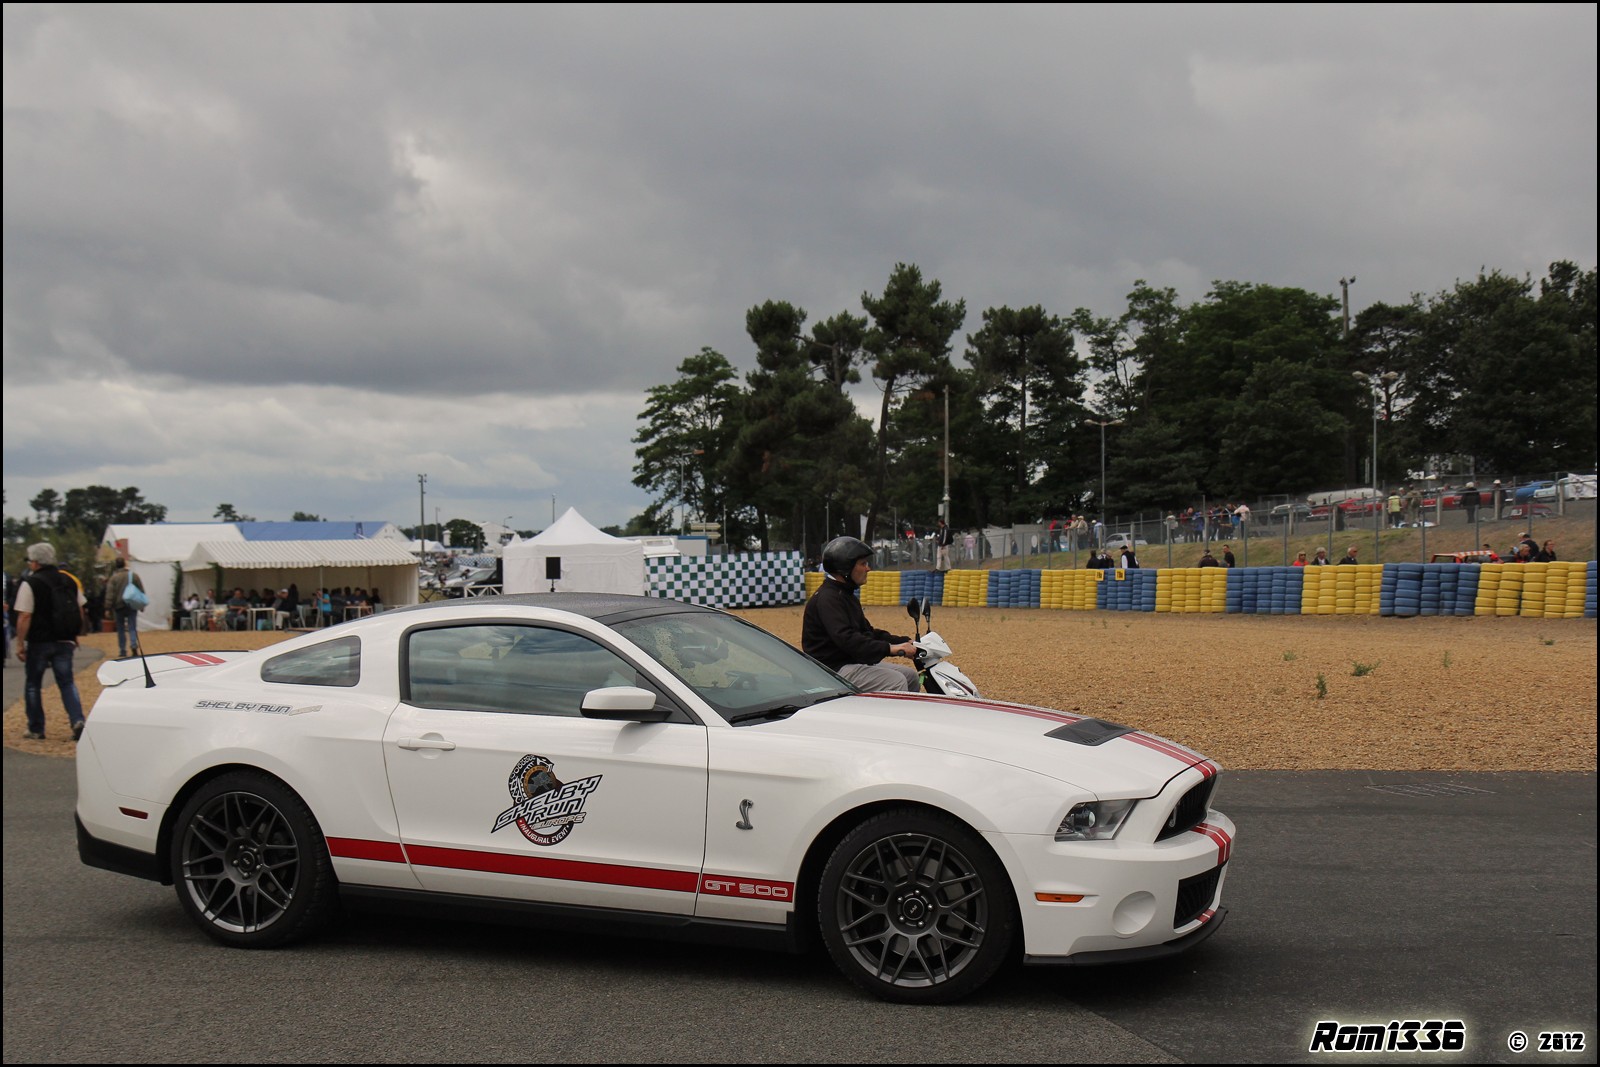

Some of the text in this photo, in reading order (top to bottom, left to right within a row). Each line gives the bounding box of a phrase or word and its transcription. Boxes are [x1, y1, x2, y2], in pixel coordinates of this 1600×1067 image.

[194, 699, 257, 712] SHELBY
[257, 702, 293, 714] RUN
[492, 774, 602, 832] SHELBY
[526, 798, 584, 825] RUN
[531, 812, 586, 830] EUROPE
[519, 823, 569, 844] INAUGURAL EVENT
[704, 879, 789, 898] GT 500
